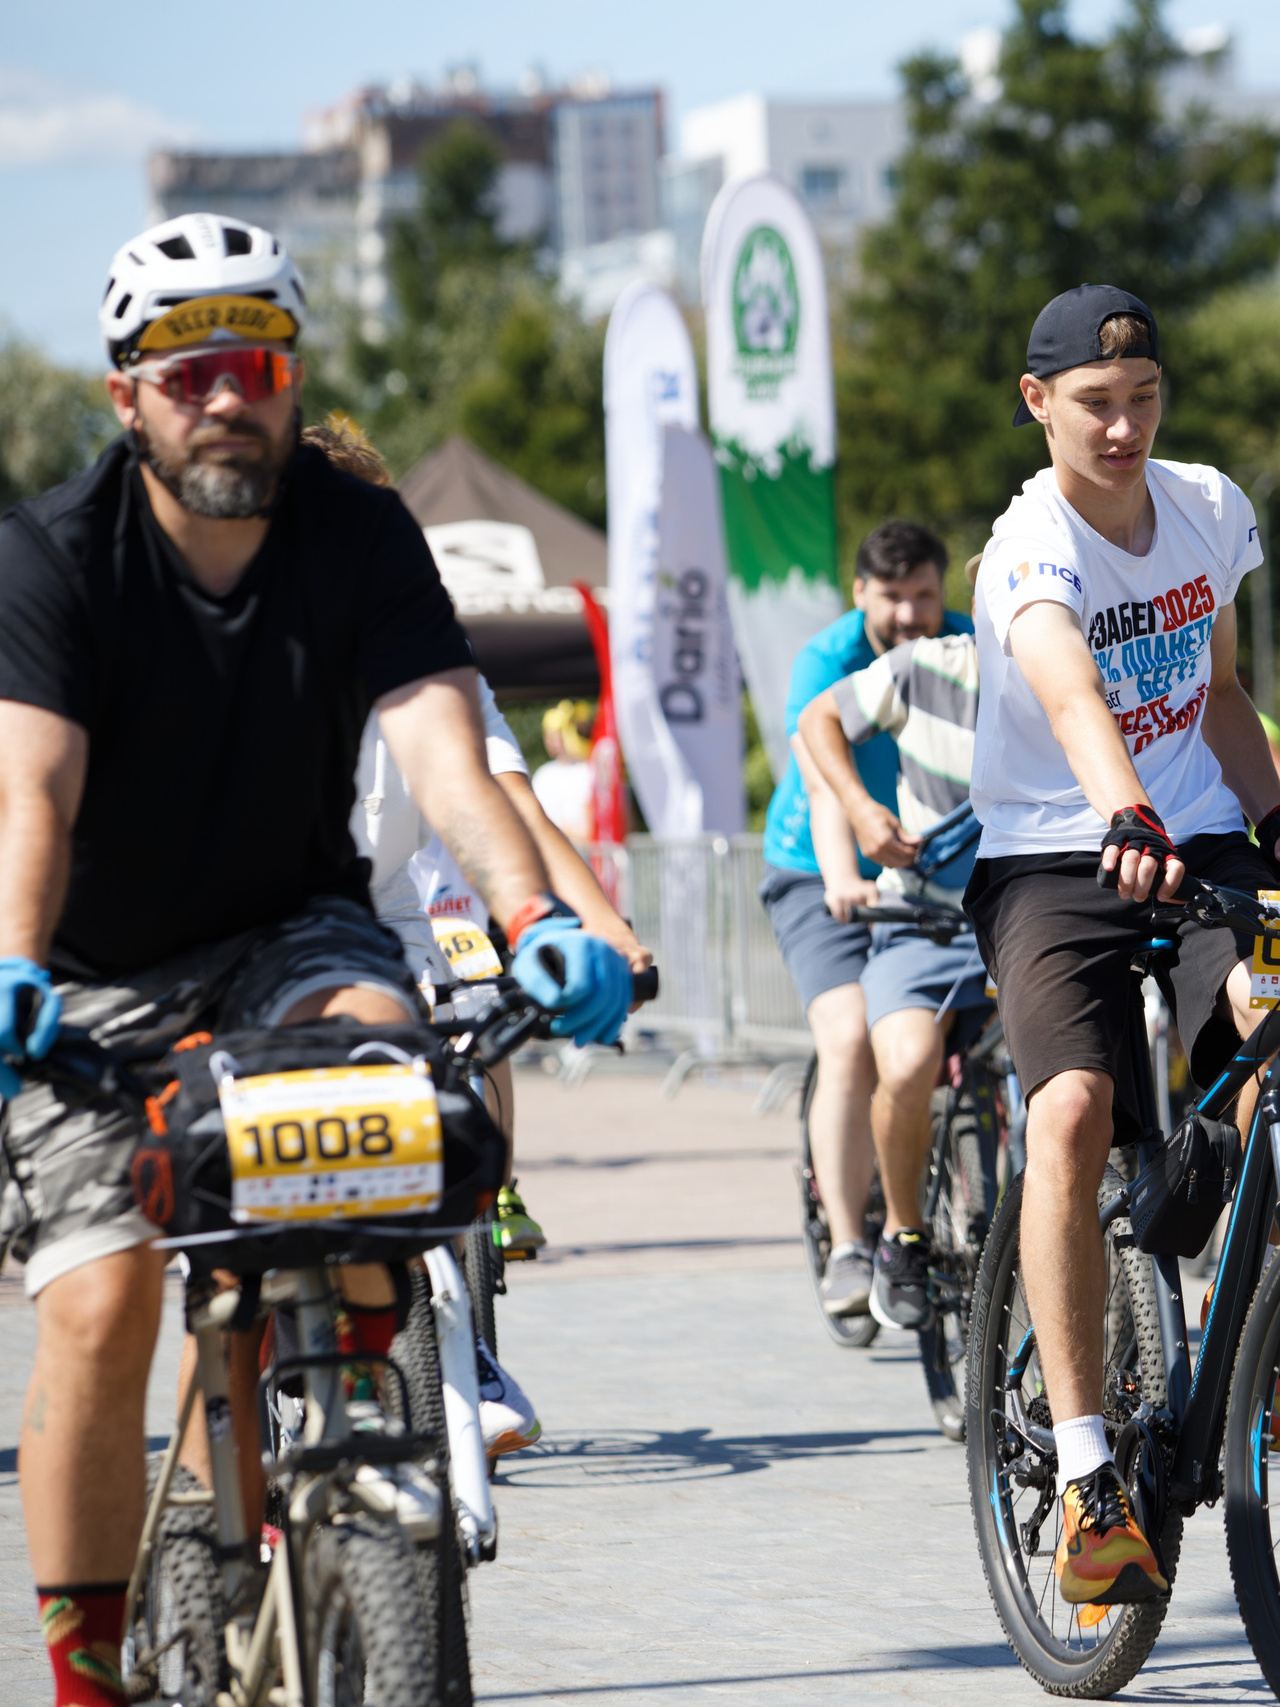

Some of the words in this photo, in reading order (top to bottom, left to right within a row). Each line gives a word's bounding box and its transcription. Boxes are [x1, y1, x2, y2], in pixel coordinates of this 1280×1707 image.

[1038, 562, 1082, 594] ПСБ
[660, 568, 709, 725] Dario
[1114, 694, 1173, 736] ЕСТЕ
[244, 1113, 394, 1166] 1008
[969, 1289, 991, 1409] MERIDA
